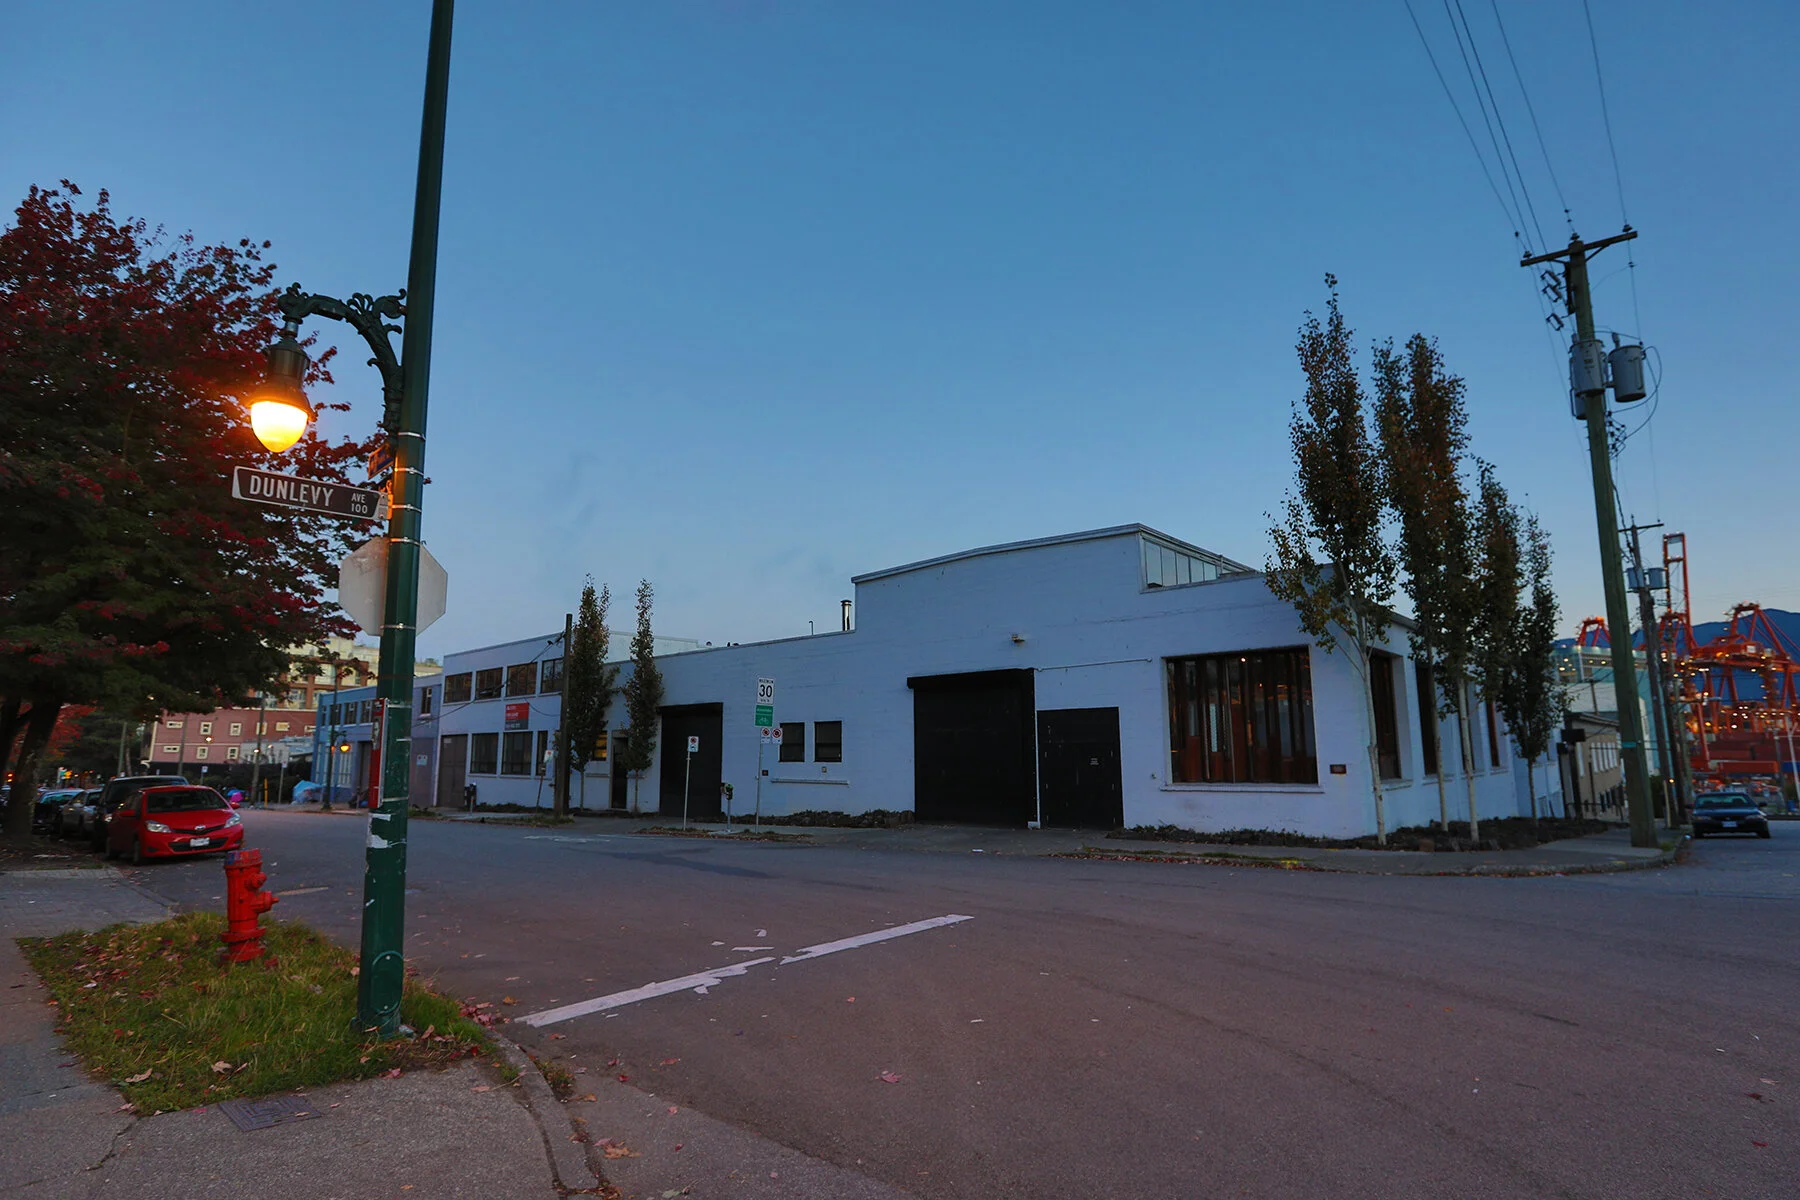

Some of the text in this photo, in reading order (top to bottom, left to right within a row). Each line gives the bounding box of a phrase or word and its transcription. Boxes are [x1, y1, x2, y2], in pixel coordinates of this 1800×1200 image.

[250, 475, 366, 507] DUNLEVY AVE
[351, 503, 368, 514] 100
[759, 684, 773, 698] 30
